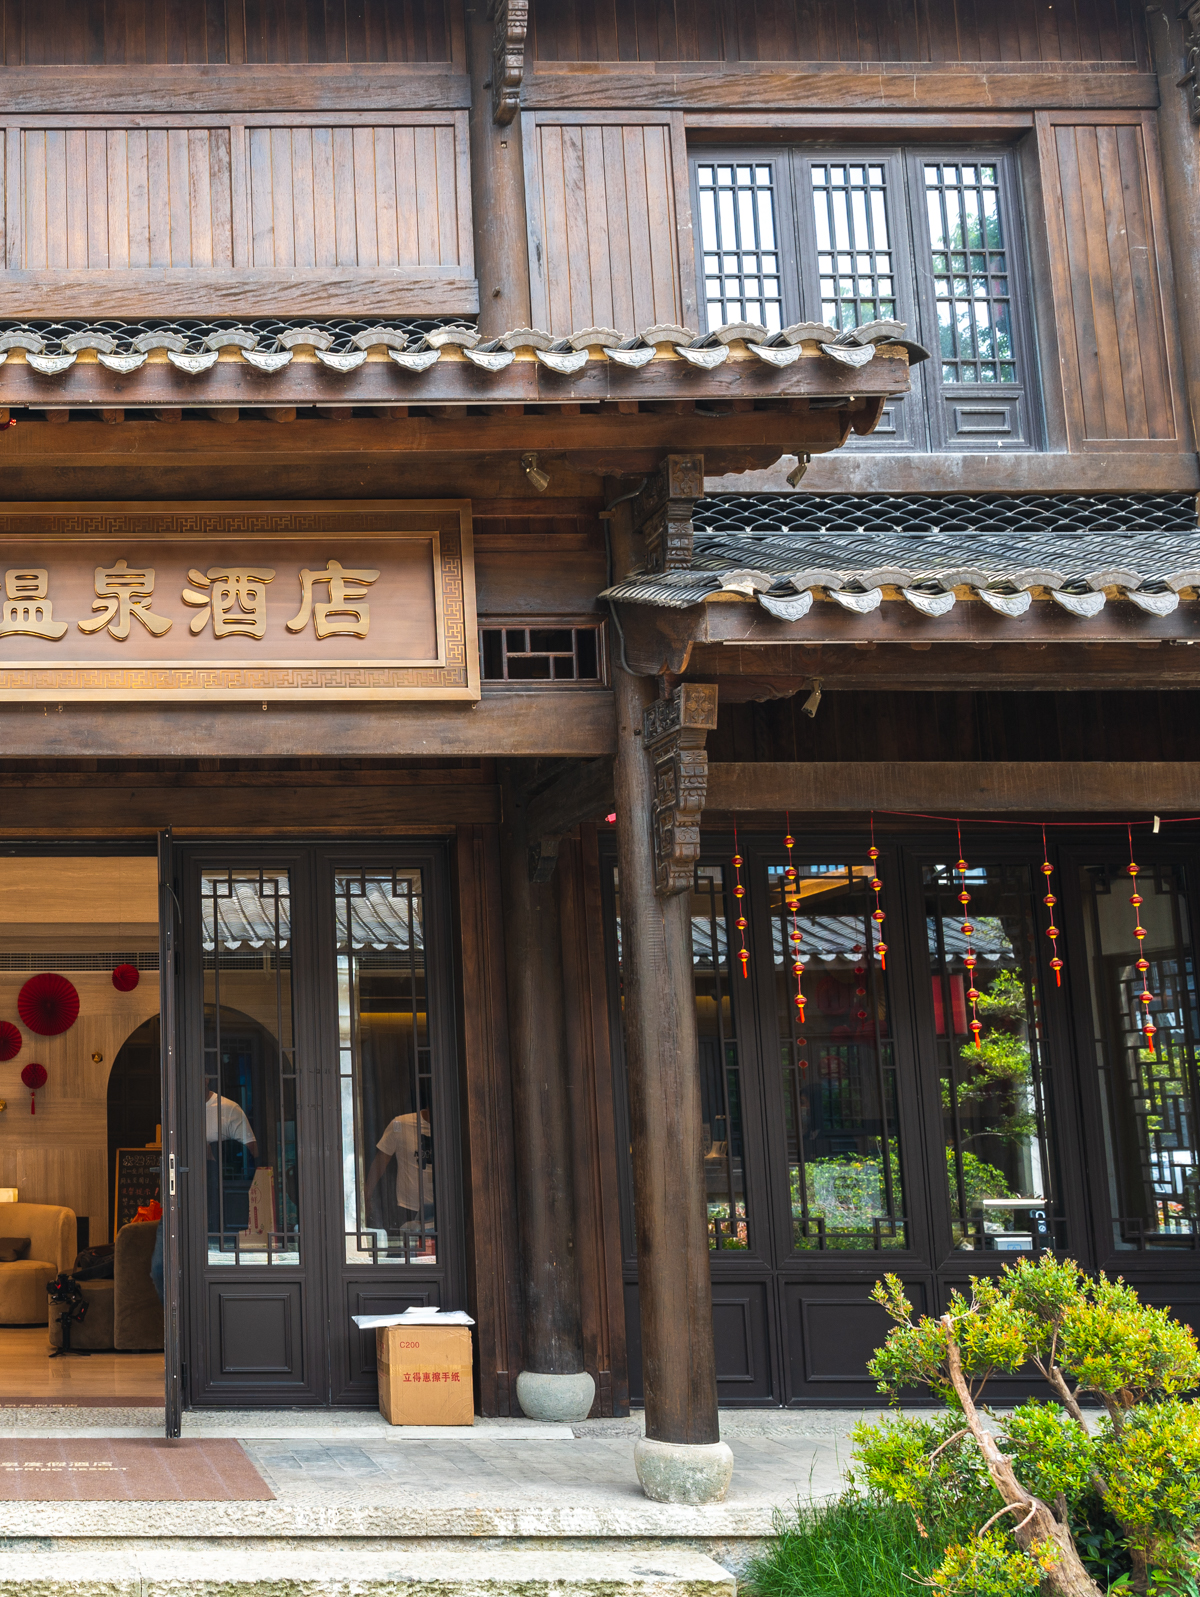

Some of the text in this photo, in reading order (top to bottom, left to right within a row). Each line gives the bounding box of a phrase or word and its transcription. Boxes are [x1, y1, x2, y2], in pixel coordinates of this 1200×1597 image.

[399, 1341, 420, 1349] C200
[403, 1372, 460, 1382] 立得惠擦手纸
